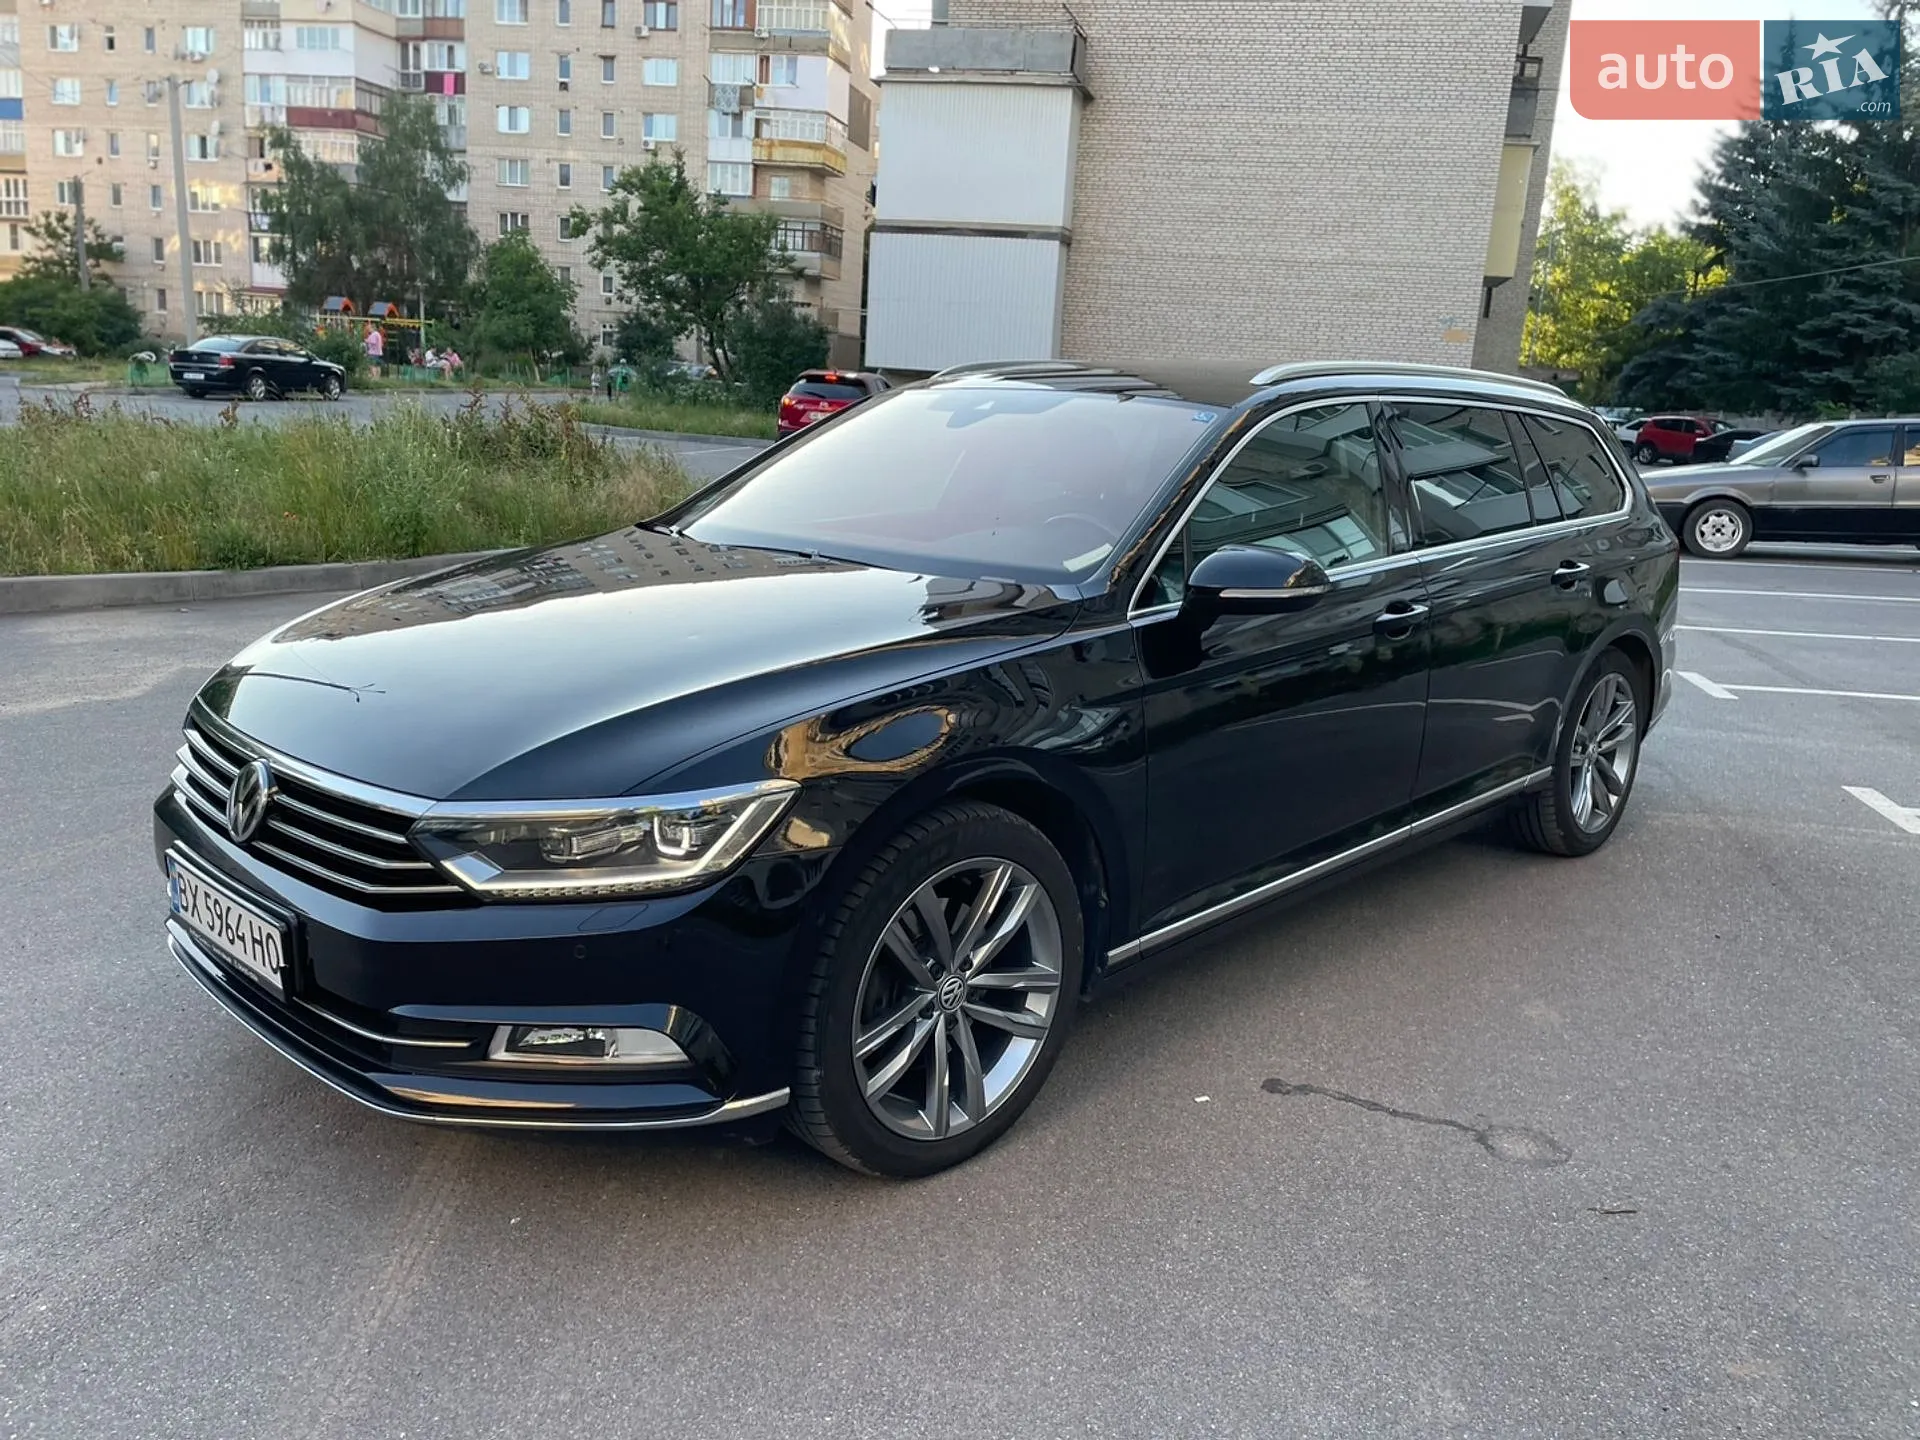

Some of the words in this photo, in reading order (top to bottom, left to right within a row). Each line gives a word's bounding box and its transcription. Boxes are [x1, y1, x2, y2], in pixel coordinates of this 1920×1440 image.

[178, 872, 202, 924] BX
[204, 891, 247, 955] 5964
[249, 920, 280, 974] HO
